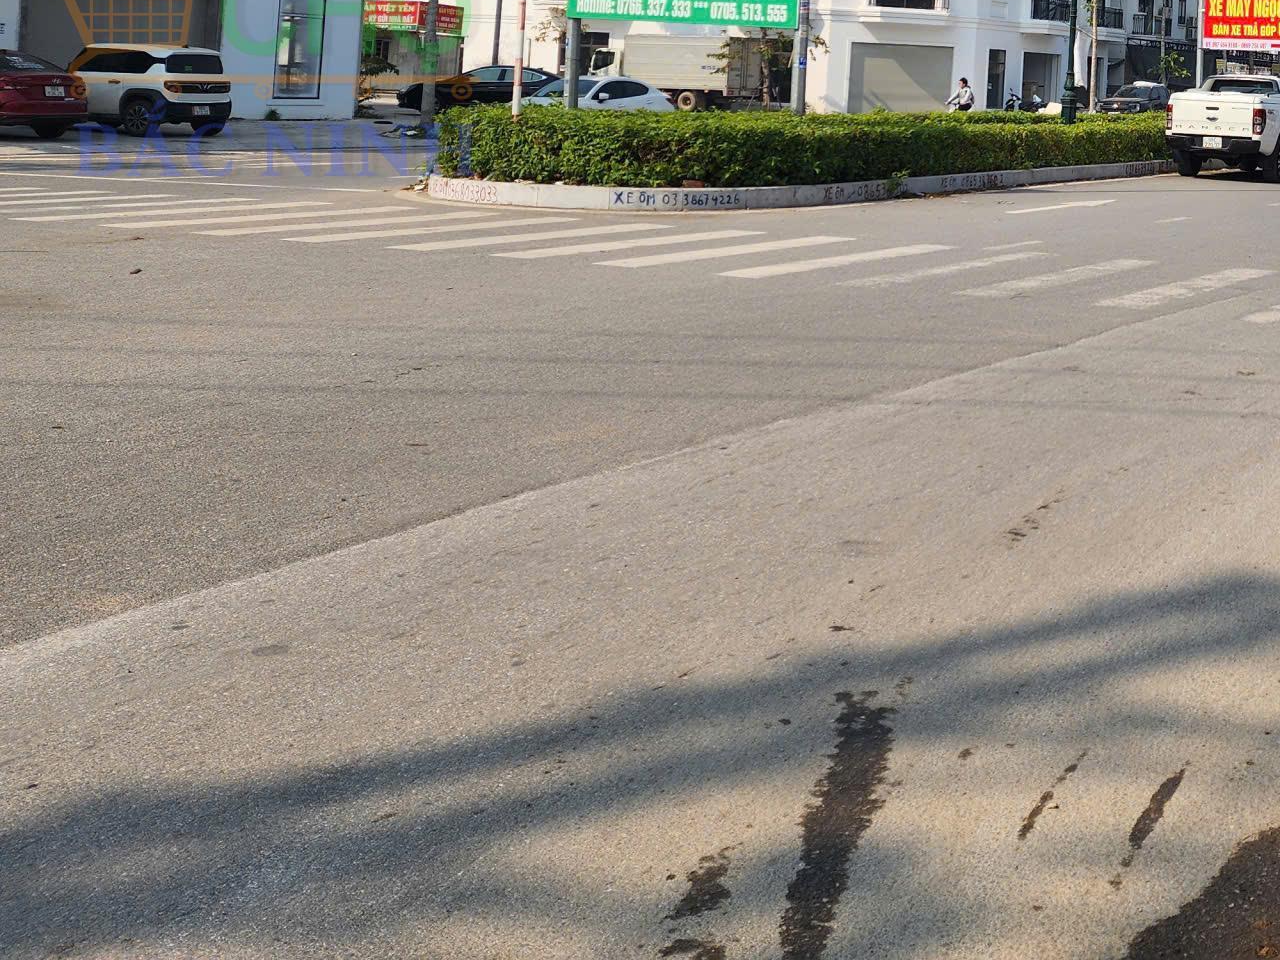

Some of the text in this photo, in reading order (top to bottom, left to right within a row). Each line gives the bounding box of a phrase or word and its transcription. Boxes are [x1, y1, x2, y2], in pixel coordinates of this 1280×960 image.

[671, 0, 691, 18] 333
[767, 4, 788, 22] 555
[1231, 24, 1242, 36] XE
[613, 191, 634, 205] XE
